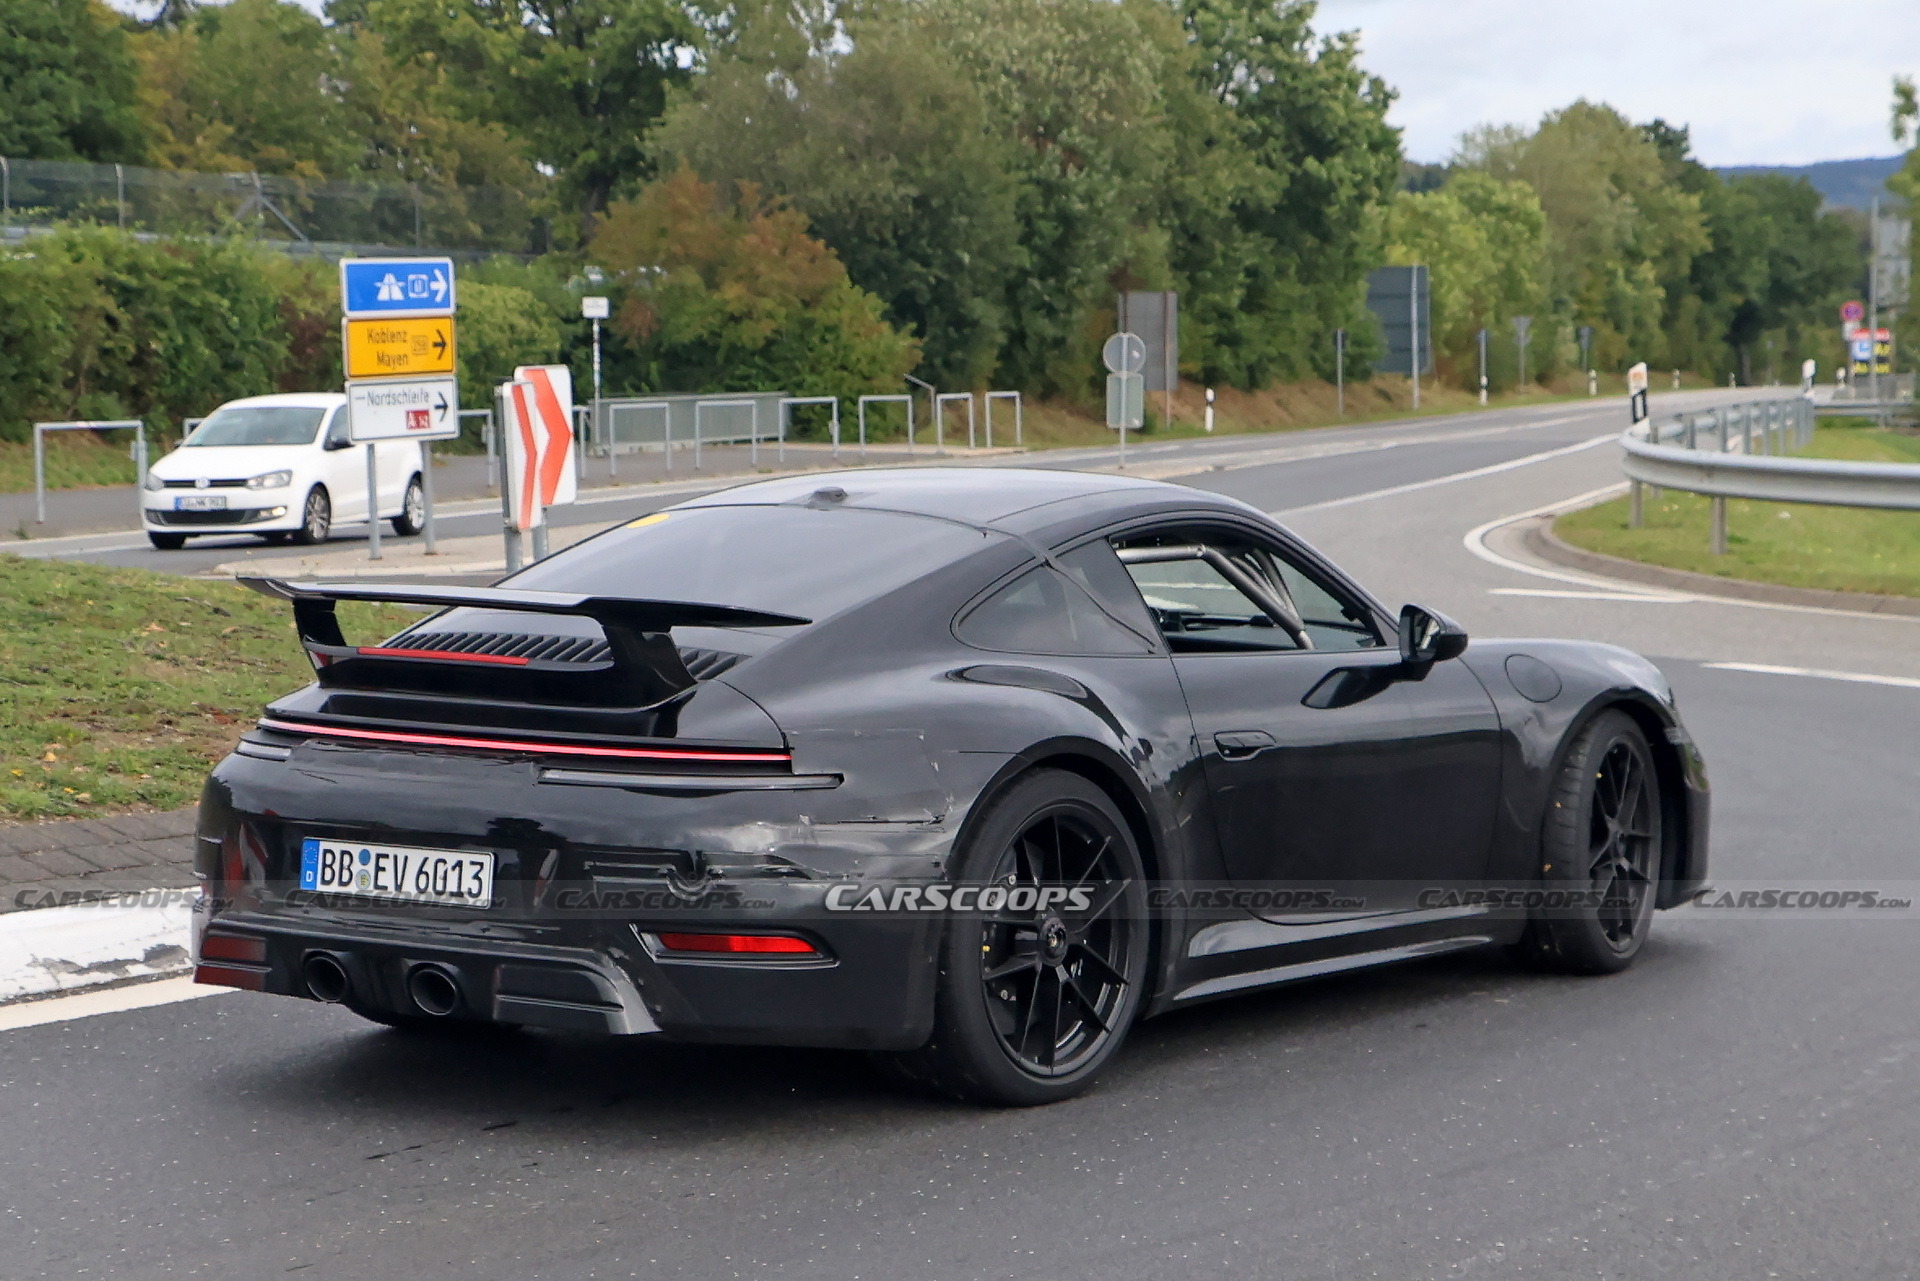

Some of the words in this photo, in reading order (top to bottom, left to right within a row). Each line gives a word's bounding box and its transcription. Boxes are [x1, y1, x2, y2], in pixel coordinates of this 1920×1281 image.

[367, 329, 407, 344] Koblenz
[377, 352, 408, 369] Mayen
[367, 388, 429, 405] Nordschleife
[305, 871, 314, 882] D
[320, 849, 354, 887] BB
[373, 853, 409, 891] EV
[415, 857, 484, 899] 6013
